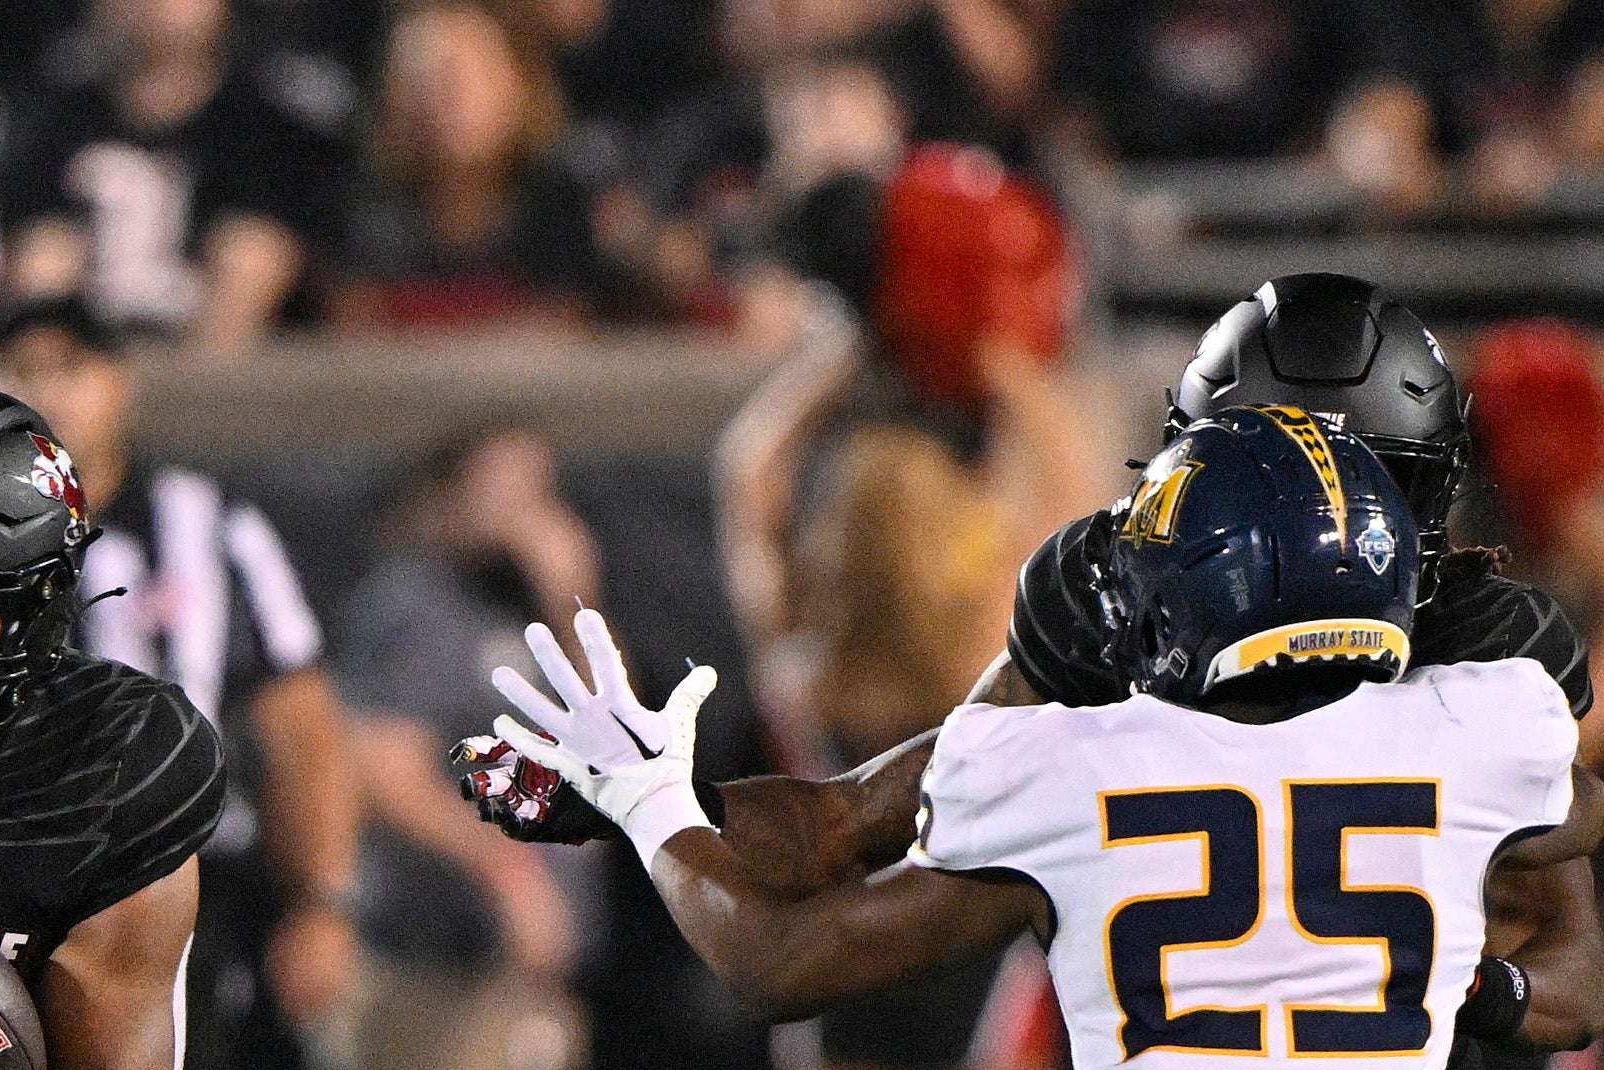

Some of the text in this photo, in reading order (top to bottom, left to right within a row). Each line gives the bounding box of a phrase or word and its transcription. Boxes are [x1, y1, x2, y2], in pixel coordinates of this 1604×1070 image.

[1288, 630, 1384, 653] MURRAY STATE
[1096, 777, 1442, 1064] 25
